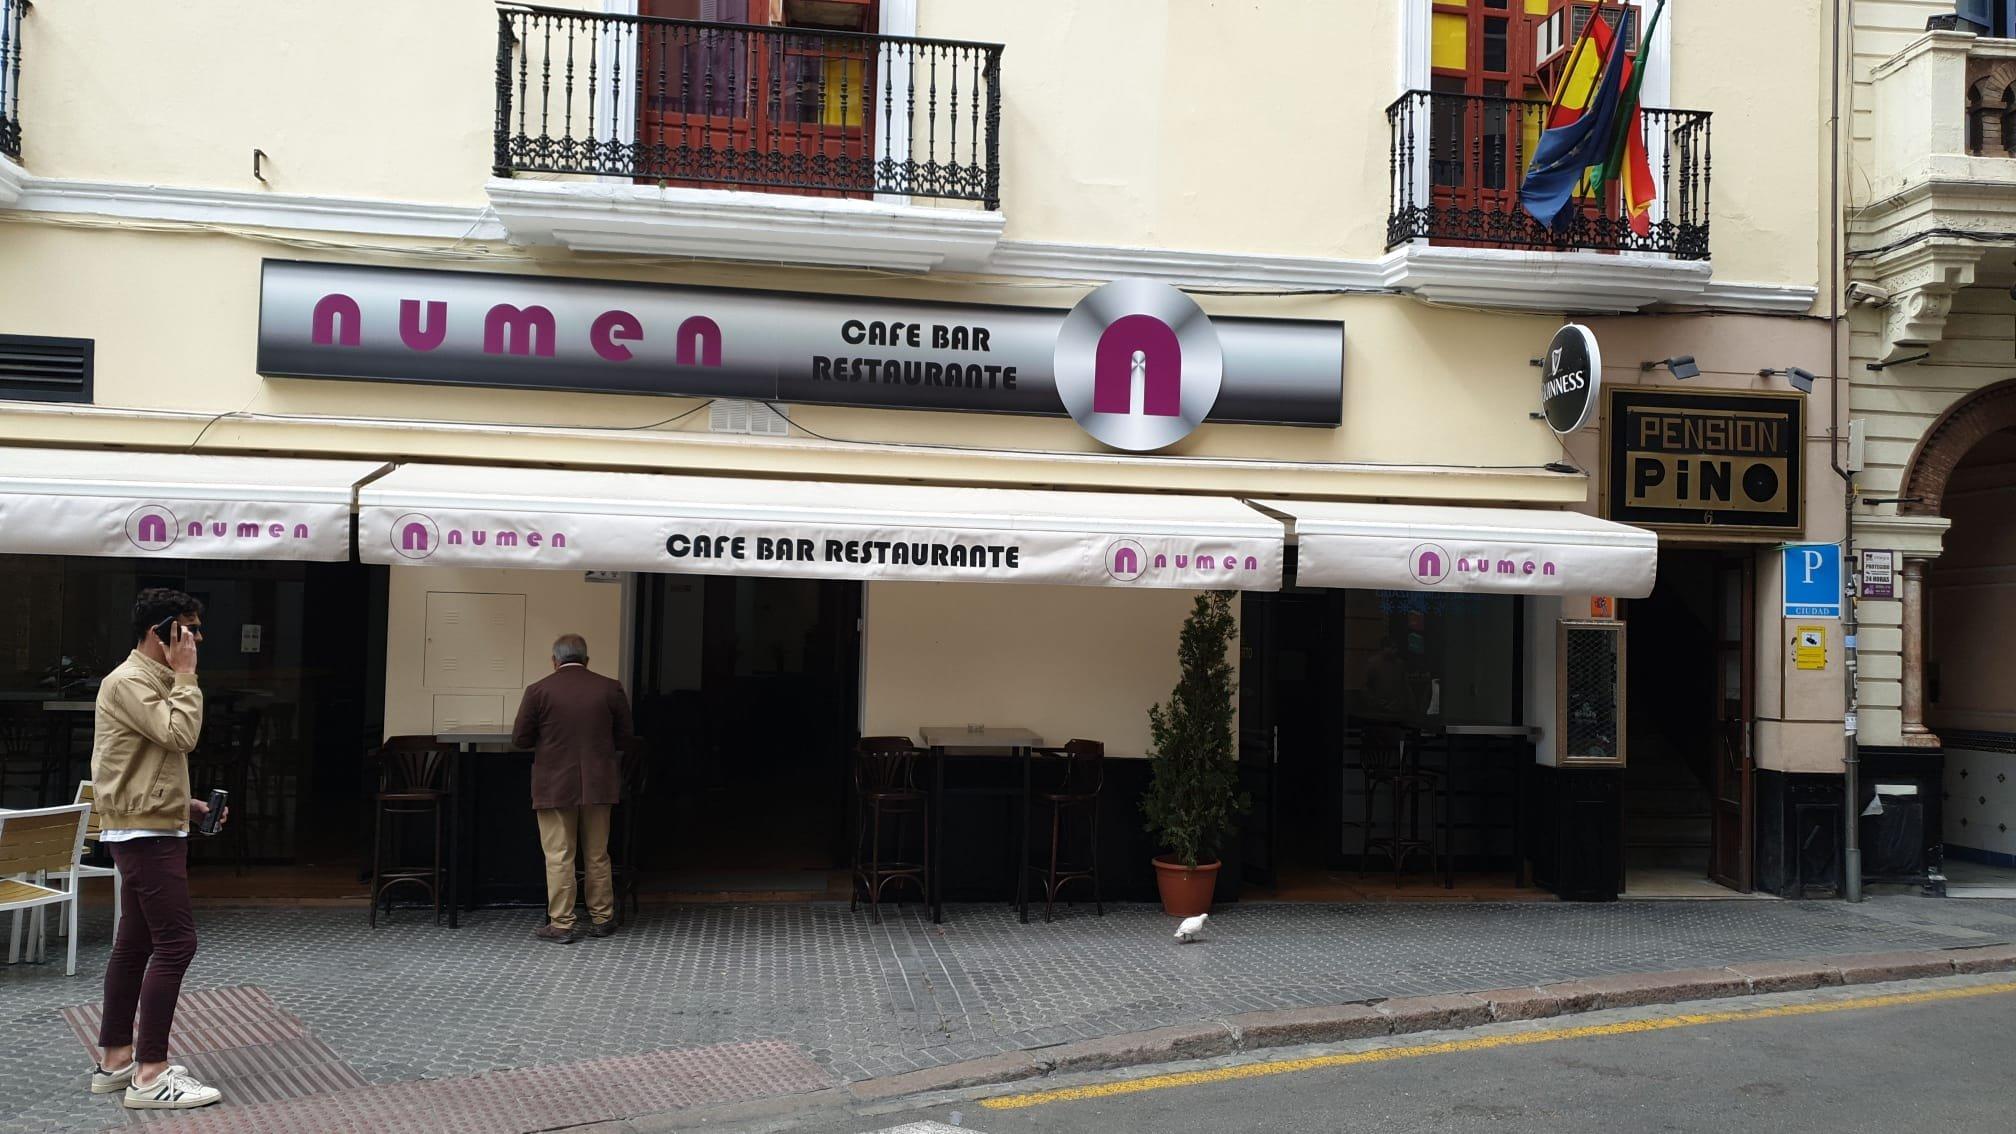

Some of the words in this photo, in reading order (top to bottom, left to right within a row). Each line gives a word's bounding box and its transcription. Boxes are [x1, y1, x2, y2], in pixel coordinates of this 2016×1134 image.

[313, 294, 721, 366] numen
[842, 320, 921, 348] CAFE
[932, 325, 990, 352] BAR
[813, 355, 1017, 389] RESTAURANTE
[1640, 416, 1777, 452] PENSION
[188, 522, 307, 537] numen
[448, 530, 565, 547] numen
[666, 534, 746, 560] CAFE
[756, 538, 815, 562] BAR
[825, 540, 1019, 569] RESTAURANTE
[1155, 555, 1256, 569] numen
[1458, 559, 1555, 574] numen
[1802, 550, 1823, 584] P
[1795, 607, 1830, 616] CIUDAD
